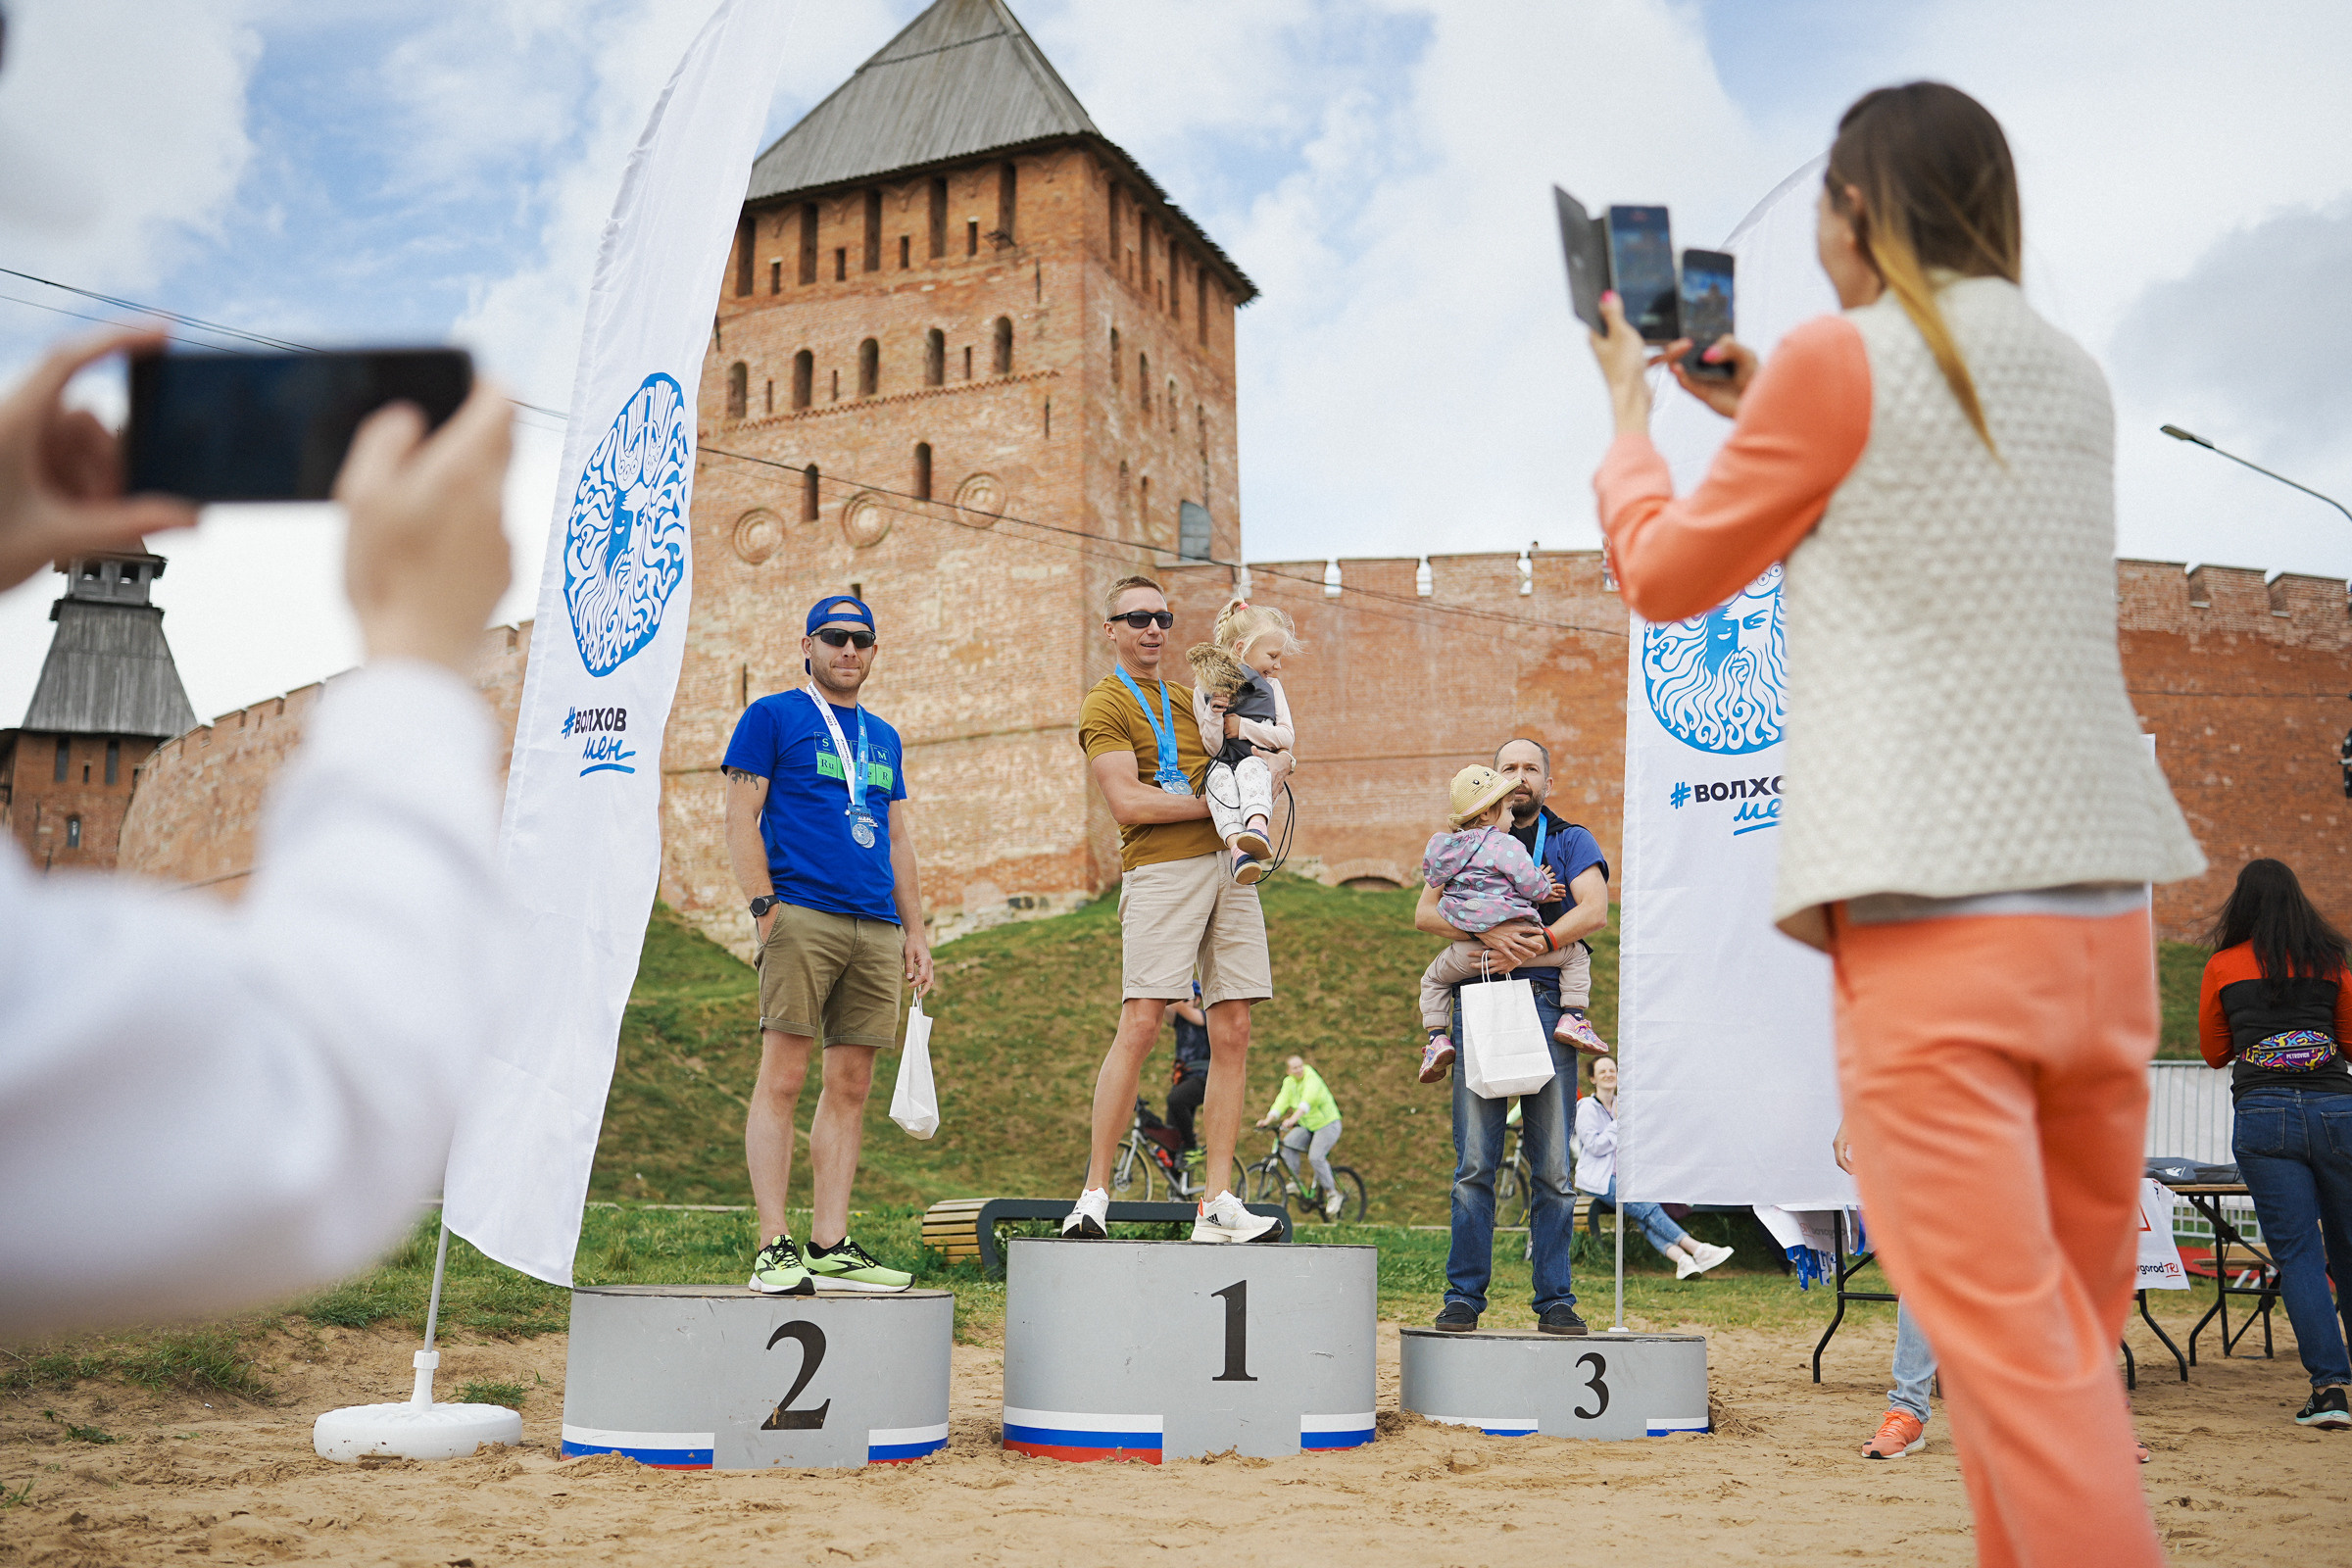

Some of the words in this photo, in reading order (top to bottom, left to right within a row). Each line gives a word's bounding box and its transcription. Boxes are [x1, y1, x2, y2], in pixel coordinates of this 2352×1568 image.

[760, 1320, 832, 1431] 2
[1210, 1279, 1258, 1382] 1
[1574, 1351, 1610, 1420] 3
